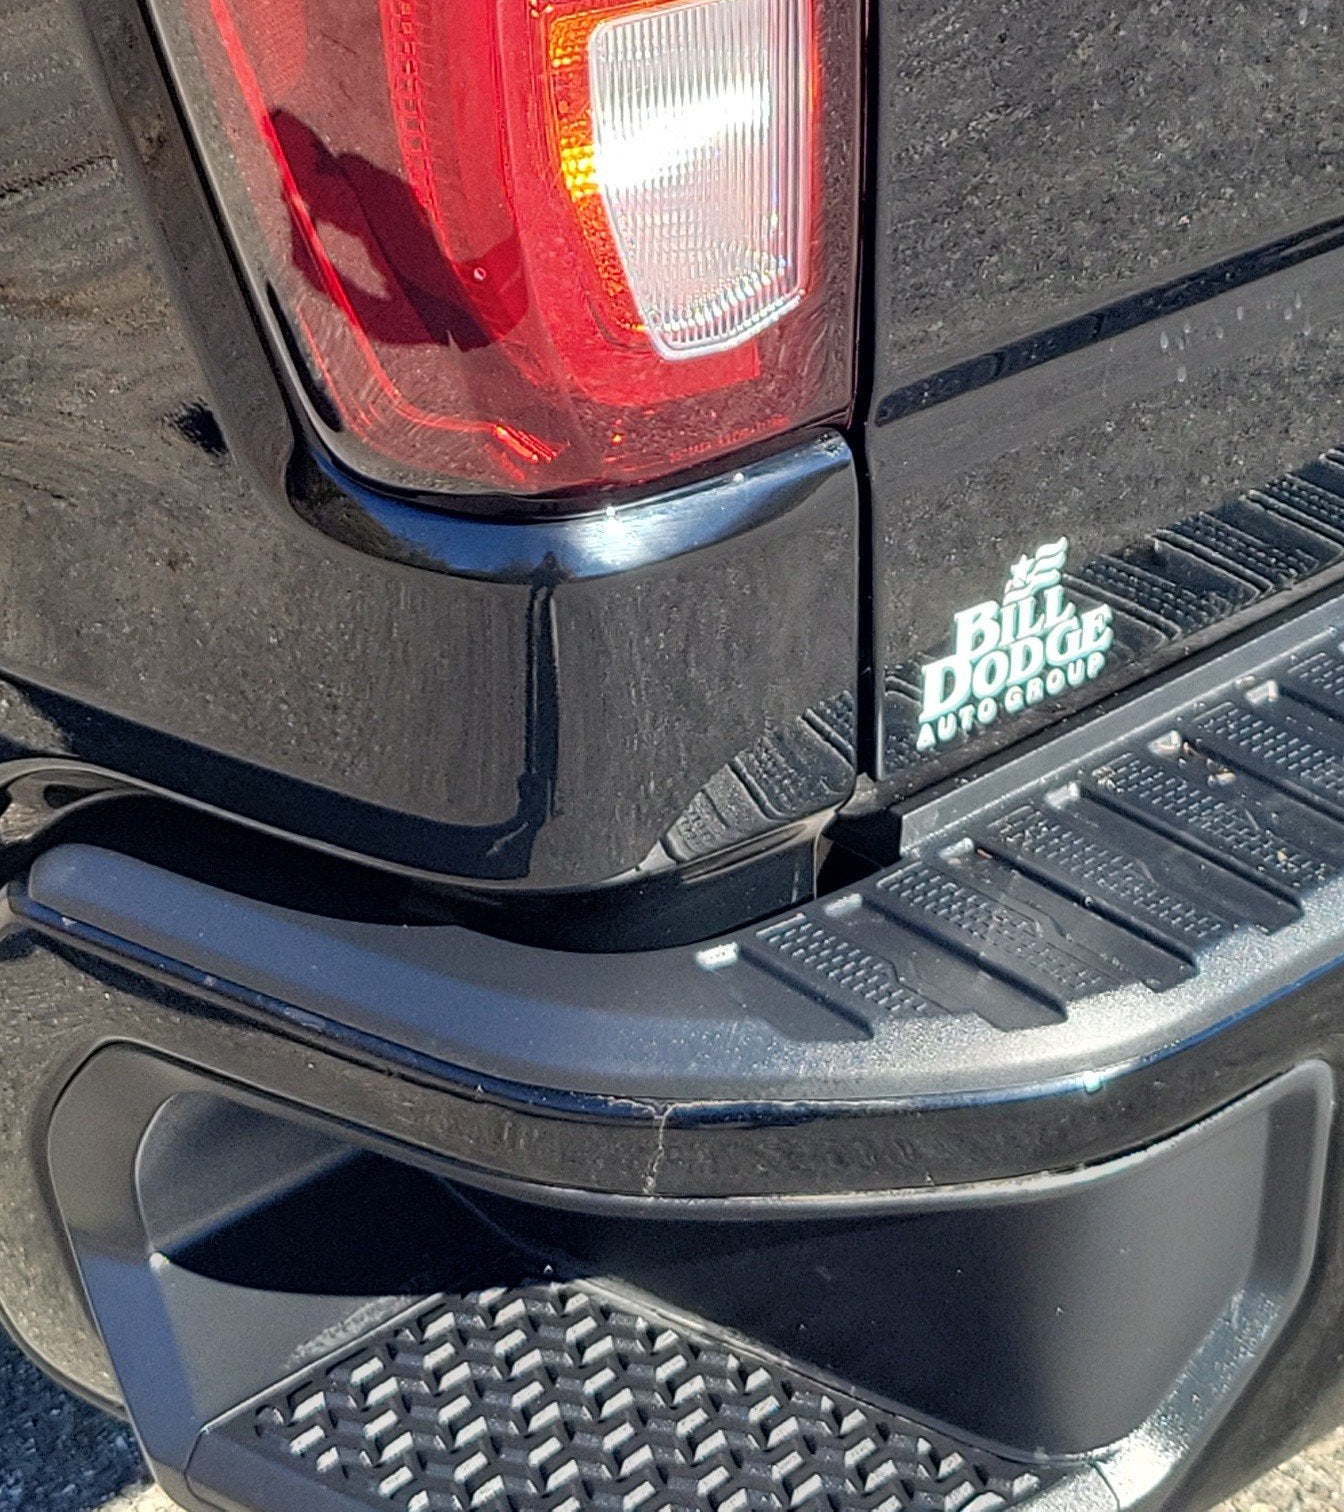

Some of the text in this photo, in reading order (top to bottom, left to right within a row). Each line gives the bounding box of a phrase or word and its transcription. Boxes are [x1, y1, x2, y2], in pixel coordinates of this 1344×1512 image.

[918, 602, 1114, 725] DODGE
[954, 584, 1076, 658] BILL
[916, 651, 1106, 751] AUTO GROUP
